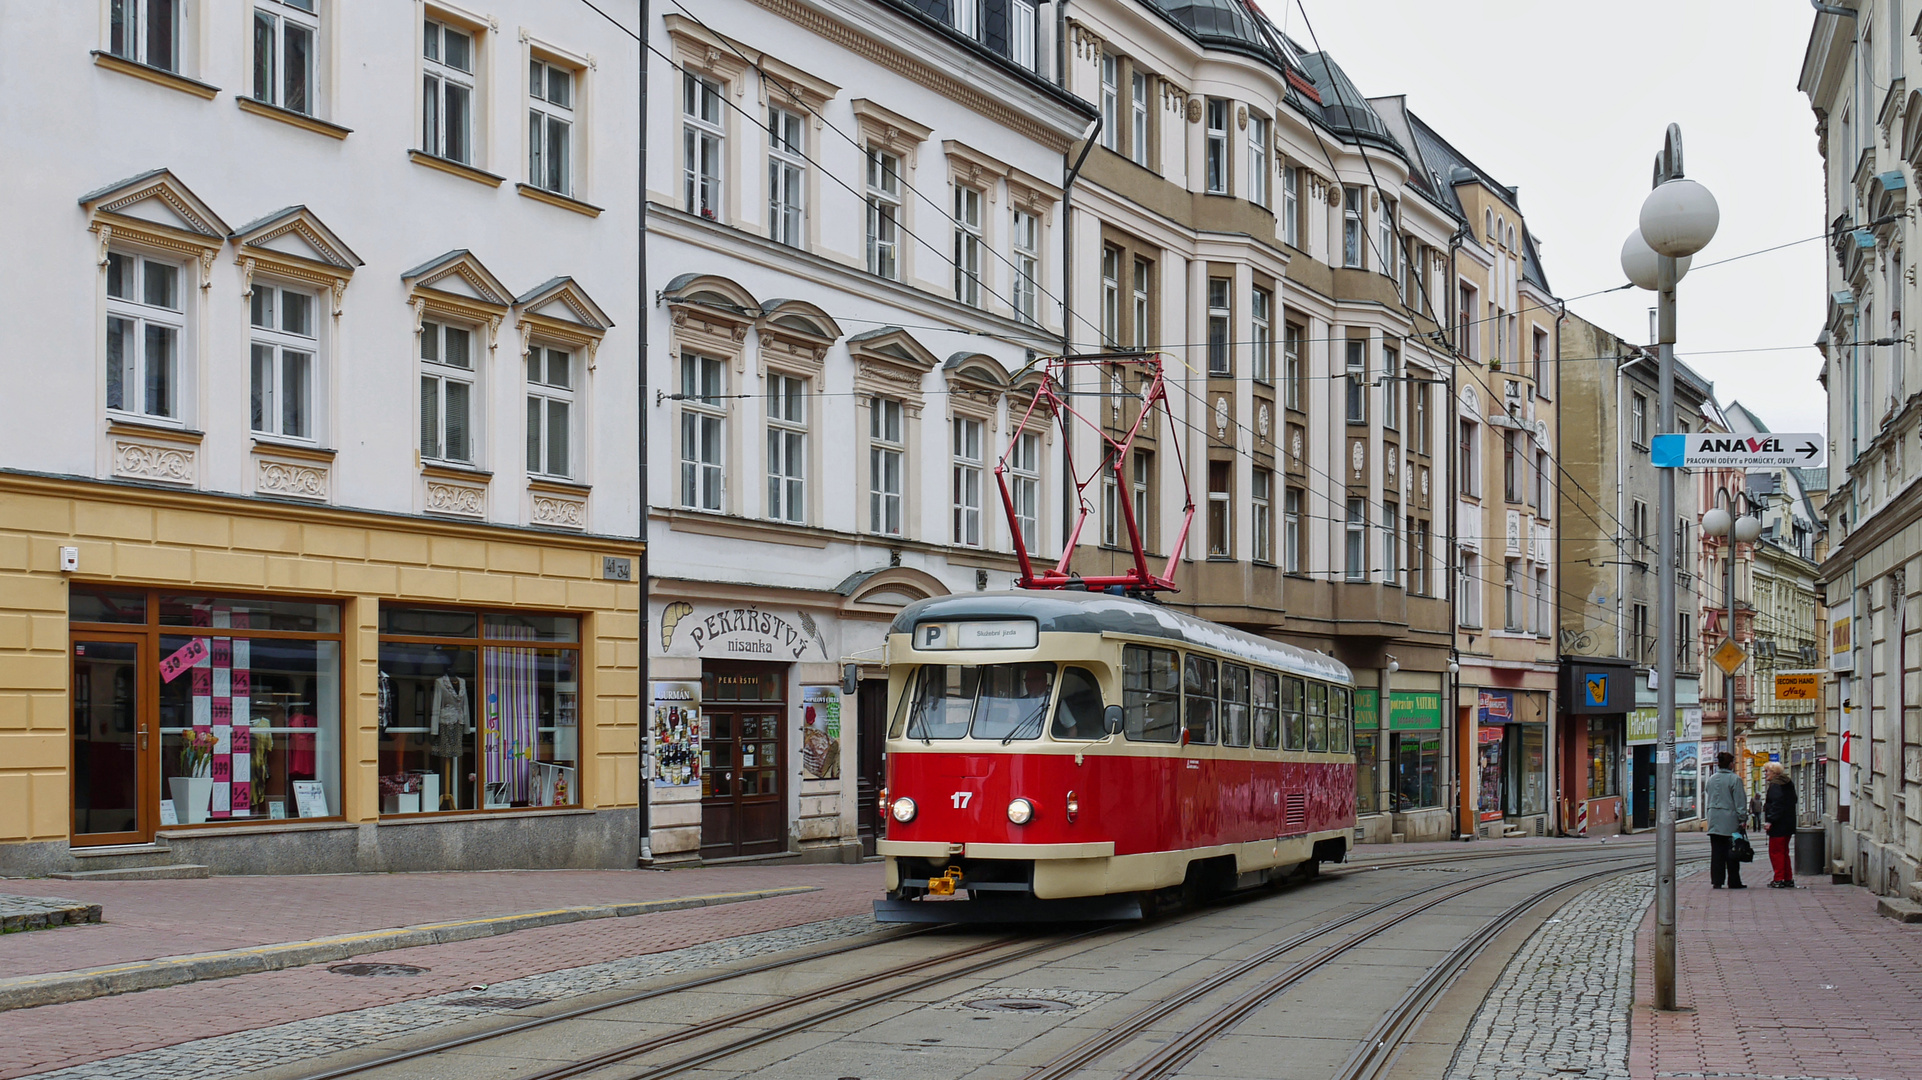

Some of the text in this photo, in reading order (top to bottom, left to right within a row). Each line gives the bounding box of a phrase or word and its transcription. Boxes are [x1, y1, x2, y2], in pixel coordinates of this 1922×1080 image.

[1699, 436, 1784, 453] ANAVEL
[1744, 456, 1776, 465] POMŮCKY,
[606, 559, 629, 578] 41 34
[690, 605, 809, 658] PEKAŘSTVÍ
[926, 626, 941, 646] P
[1002, 629, 1017, 637] jízda
[728, 639, 773, 654] nisanka
[163, 642, 203, 673] -30 -30
[1354, 694, 1372, 707] VOCE
[1390, 696, 1438, 713] potraviny NATURAL
[1355, 711, 1378, 724] ENINA
[951, 791, 973, 809] 17
